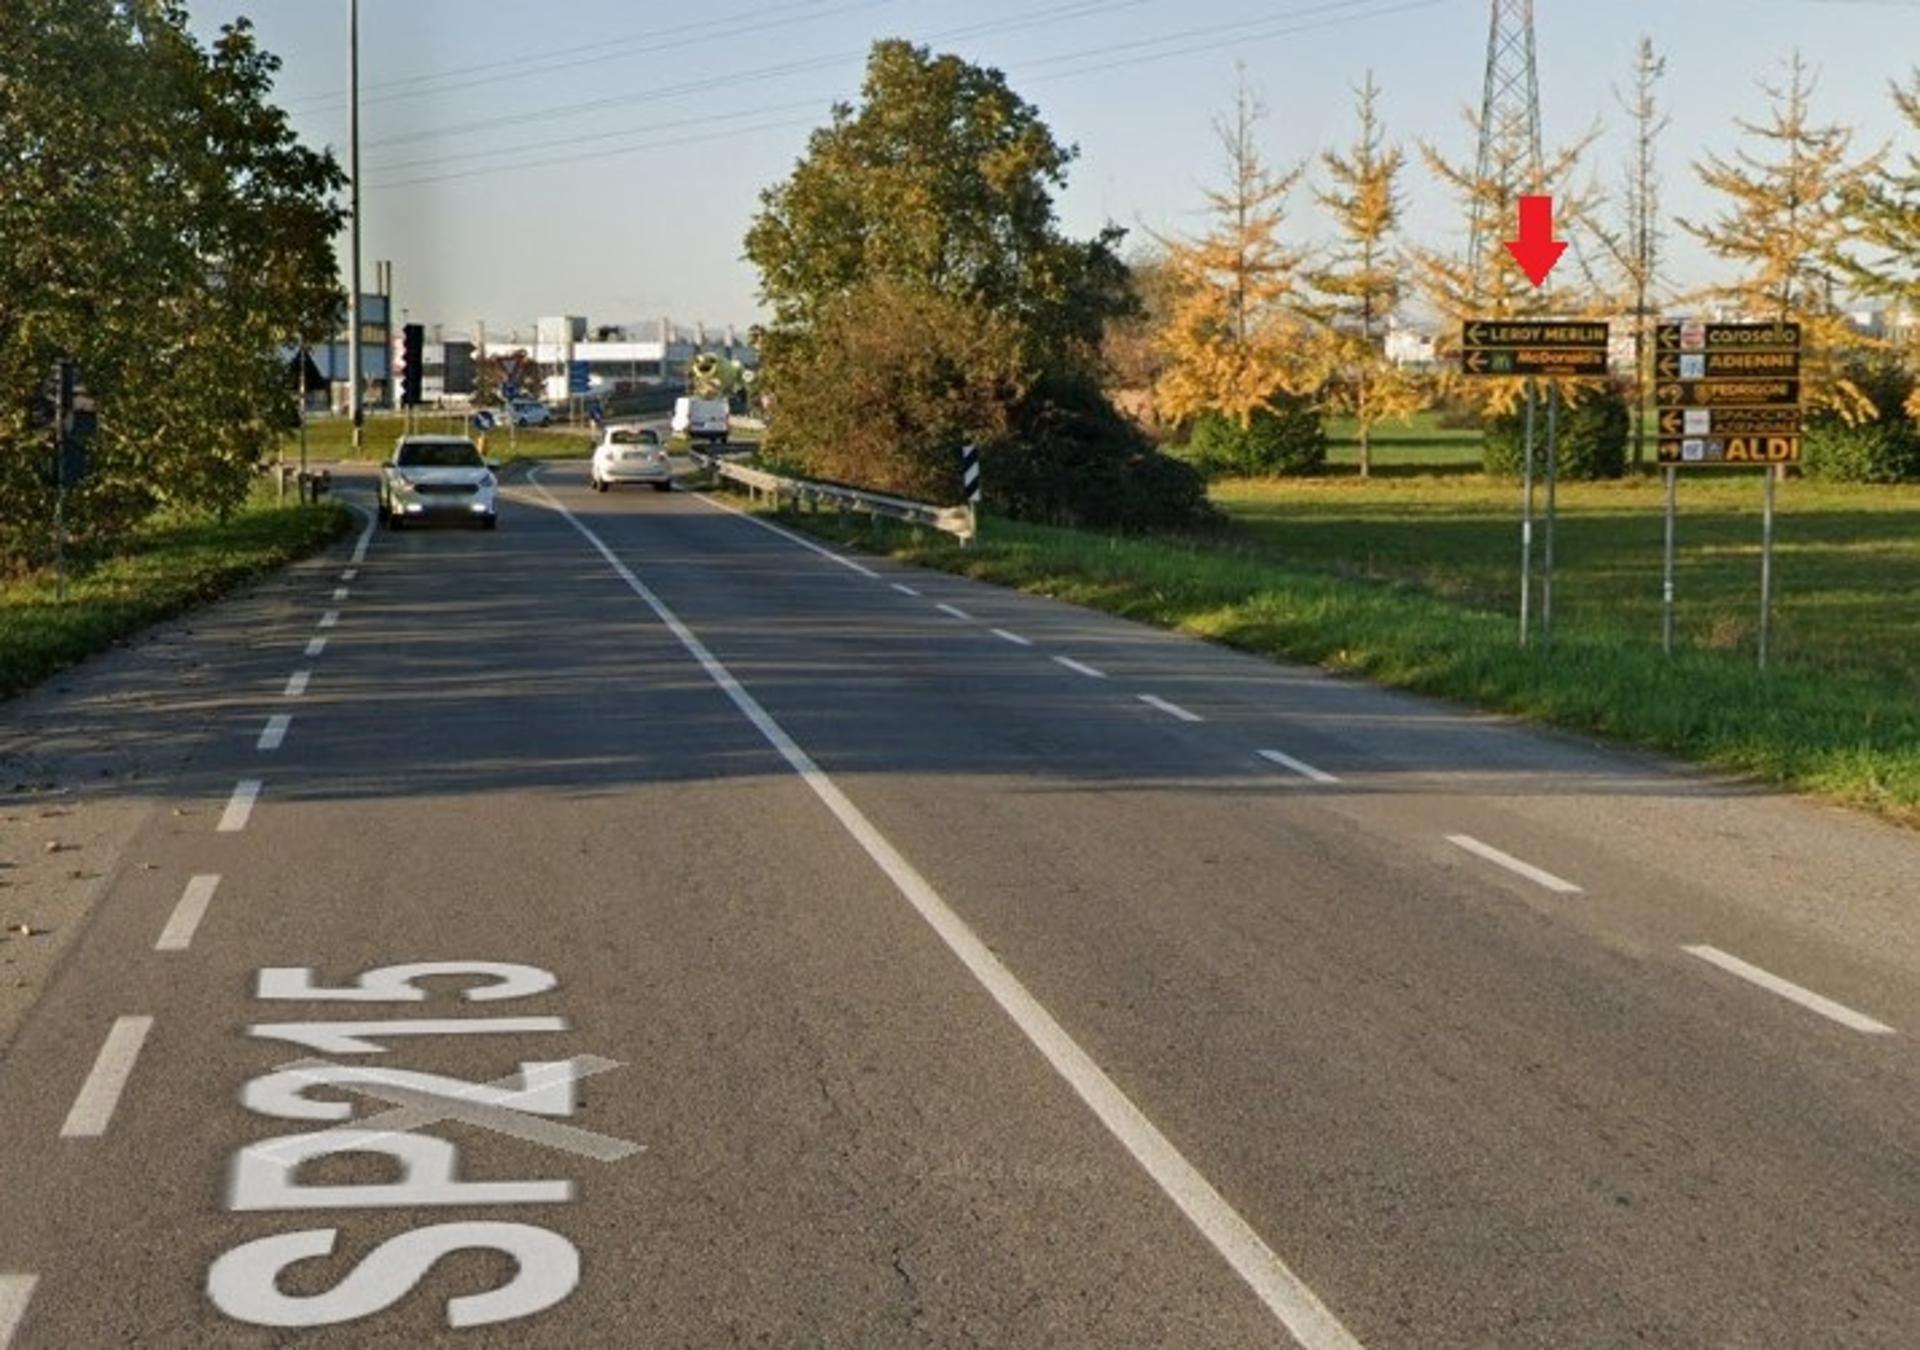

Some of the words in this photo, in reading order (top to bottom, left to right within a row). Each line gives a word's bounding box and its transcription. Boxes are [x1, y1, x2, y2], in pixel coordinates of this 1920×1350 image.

[1490, 326, 1541, 341] LEROY
[1544, 326, 1604, 341] MERLIN
[1709, 323, 1797, 343] carosello
[1709, 354, 1795, 368] ADIENNE
[1726, 437, 1799, 462] ALDI
